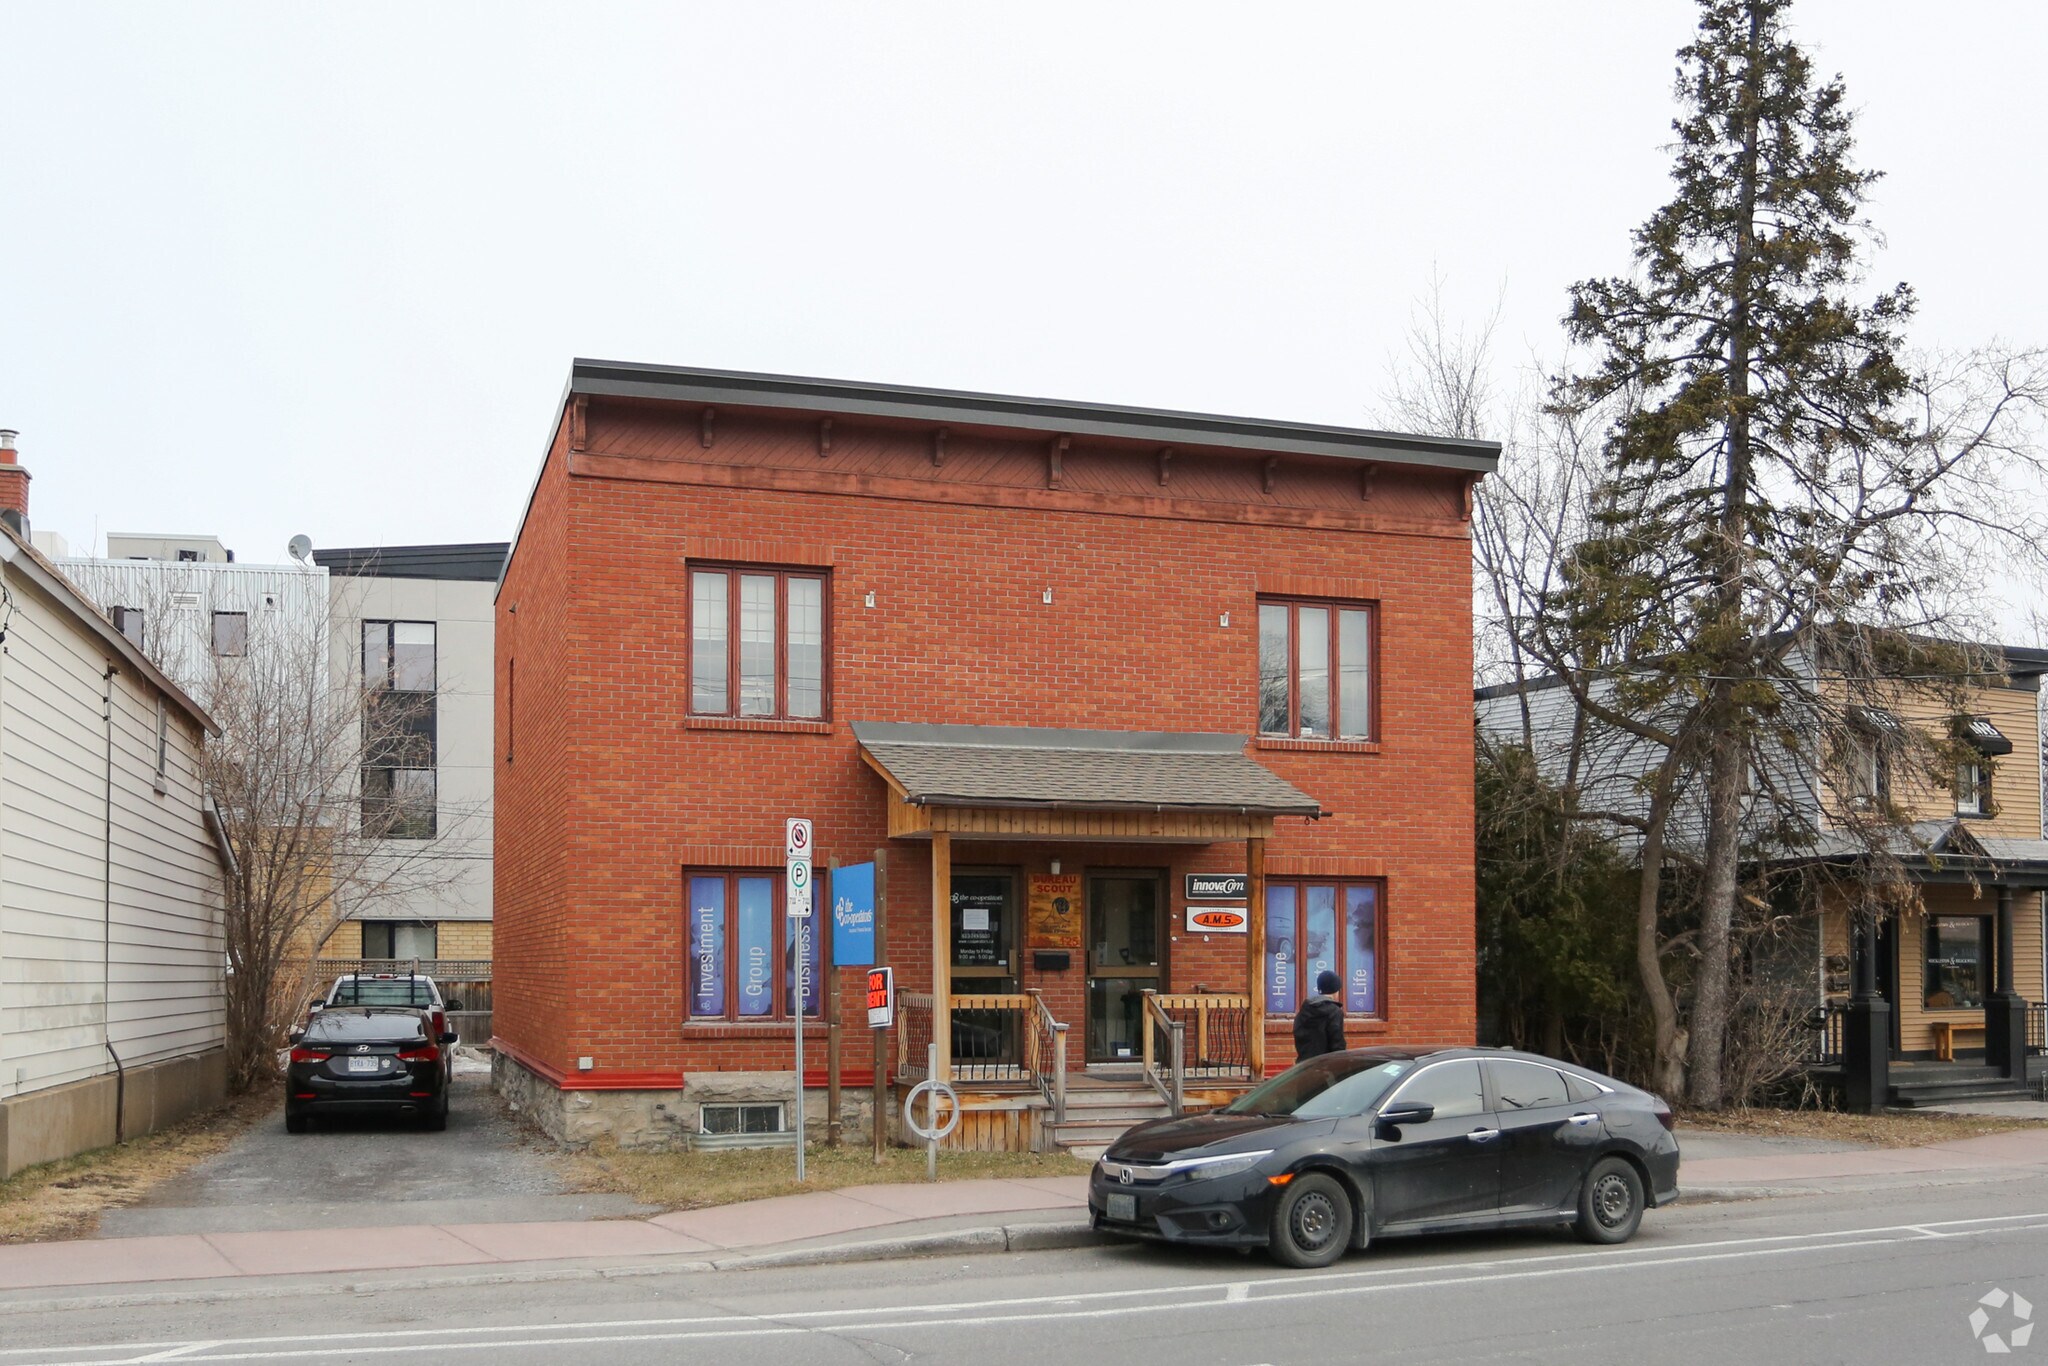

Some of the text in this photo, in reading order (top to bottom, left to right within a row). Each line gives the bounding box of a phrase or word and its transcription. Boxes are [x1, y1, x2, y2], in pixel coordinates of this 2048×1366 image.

[1968, 721, 1999, 736] MB
[795, 868, 803, 881] P
[1033, 875, 1076, 884] BUREAU
[1037, 884, 1073, 893] SCOUT
[845, 898, 854, 912] the
[1202, 914, 1234, 925] A.M.S.
[697, 907, 714, 996] Investment
[746, 947, 766, 996] Group
[1272, 952, 1287, 996] Home
[1353, 969, 1367, 995] Life
